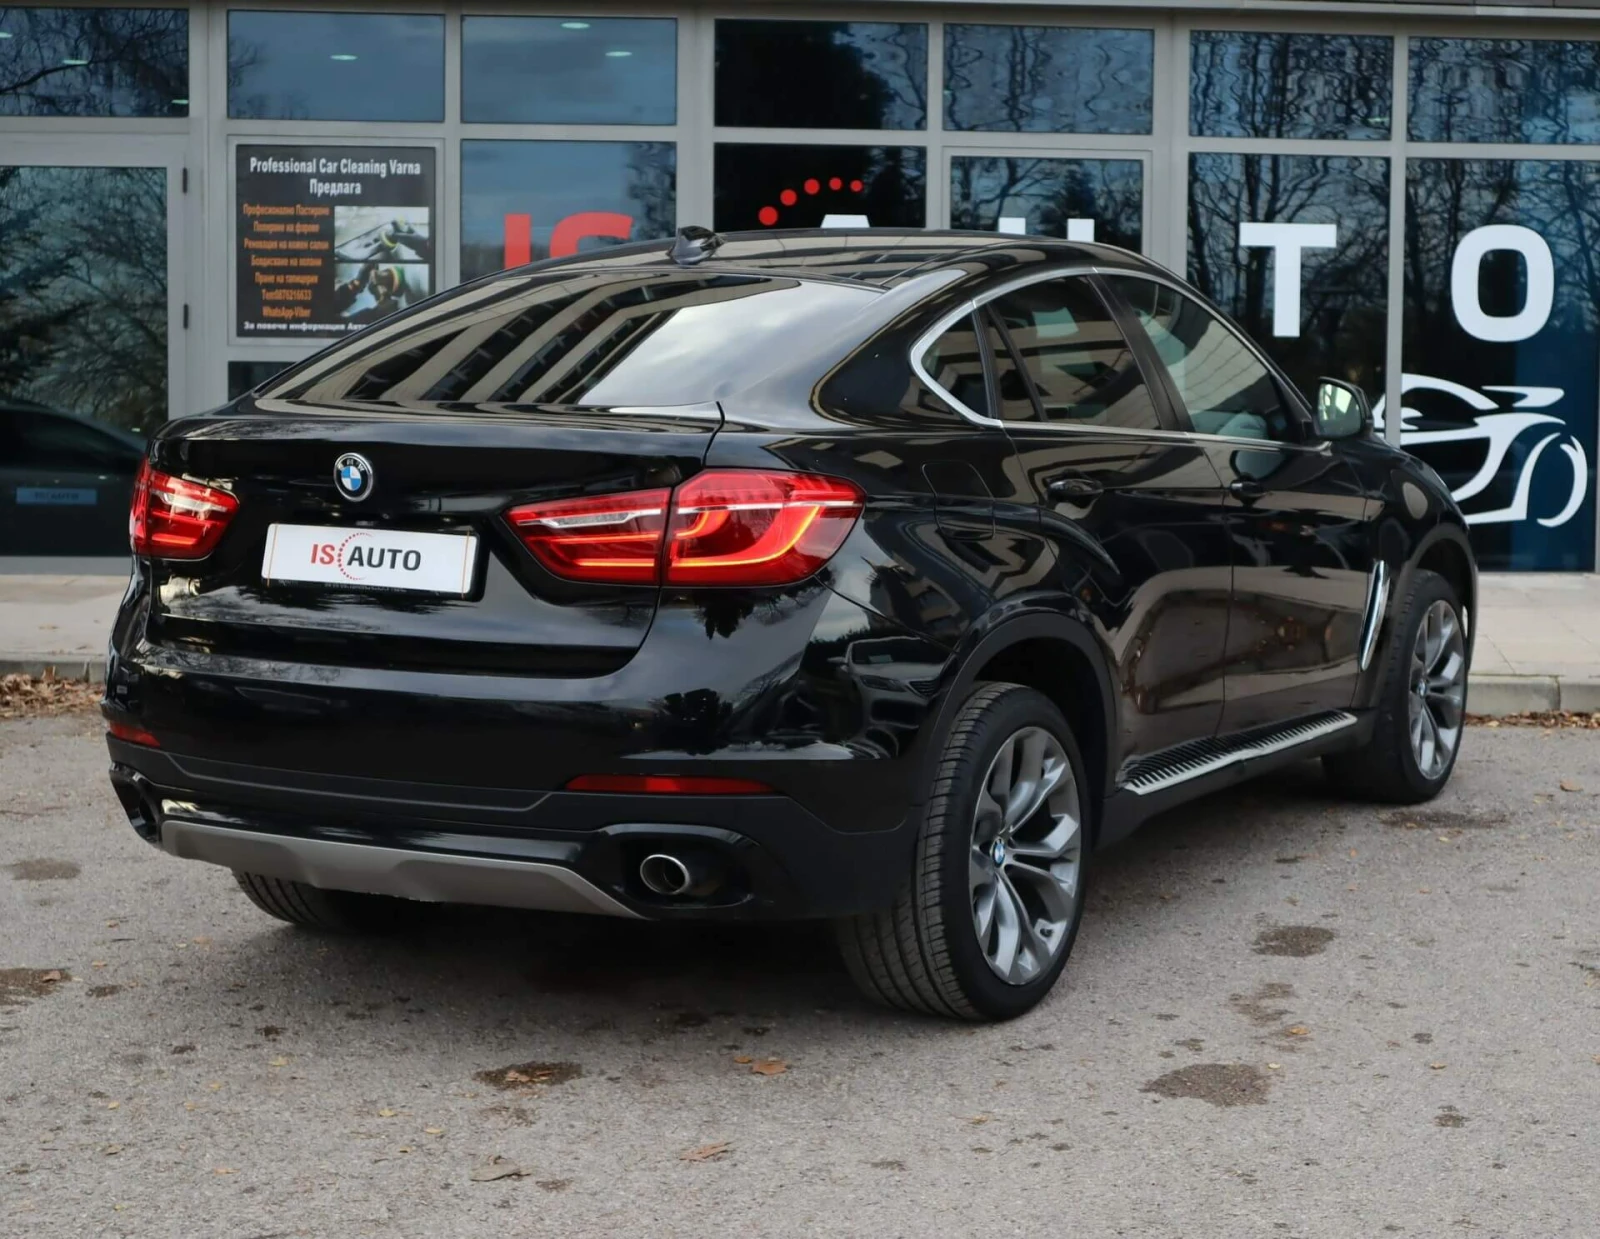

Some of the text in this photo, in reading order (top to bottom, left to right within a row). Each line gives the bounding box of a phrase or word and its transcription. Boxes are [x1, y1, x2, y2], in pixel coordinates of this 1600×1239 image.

[250, 157, 421, 178] Professional Car Cleaning Varna
[309, 178, 361, 197] Предлага
[244, 321, 255, 330] За
[289, 322, 345, 332] информация
[310, 544, 421, 571] IS AUTO
